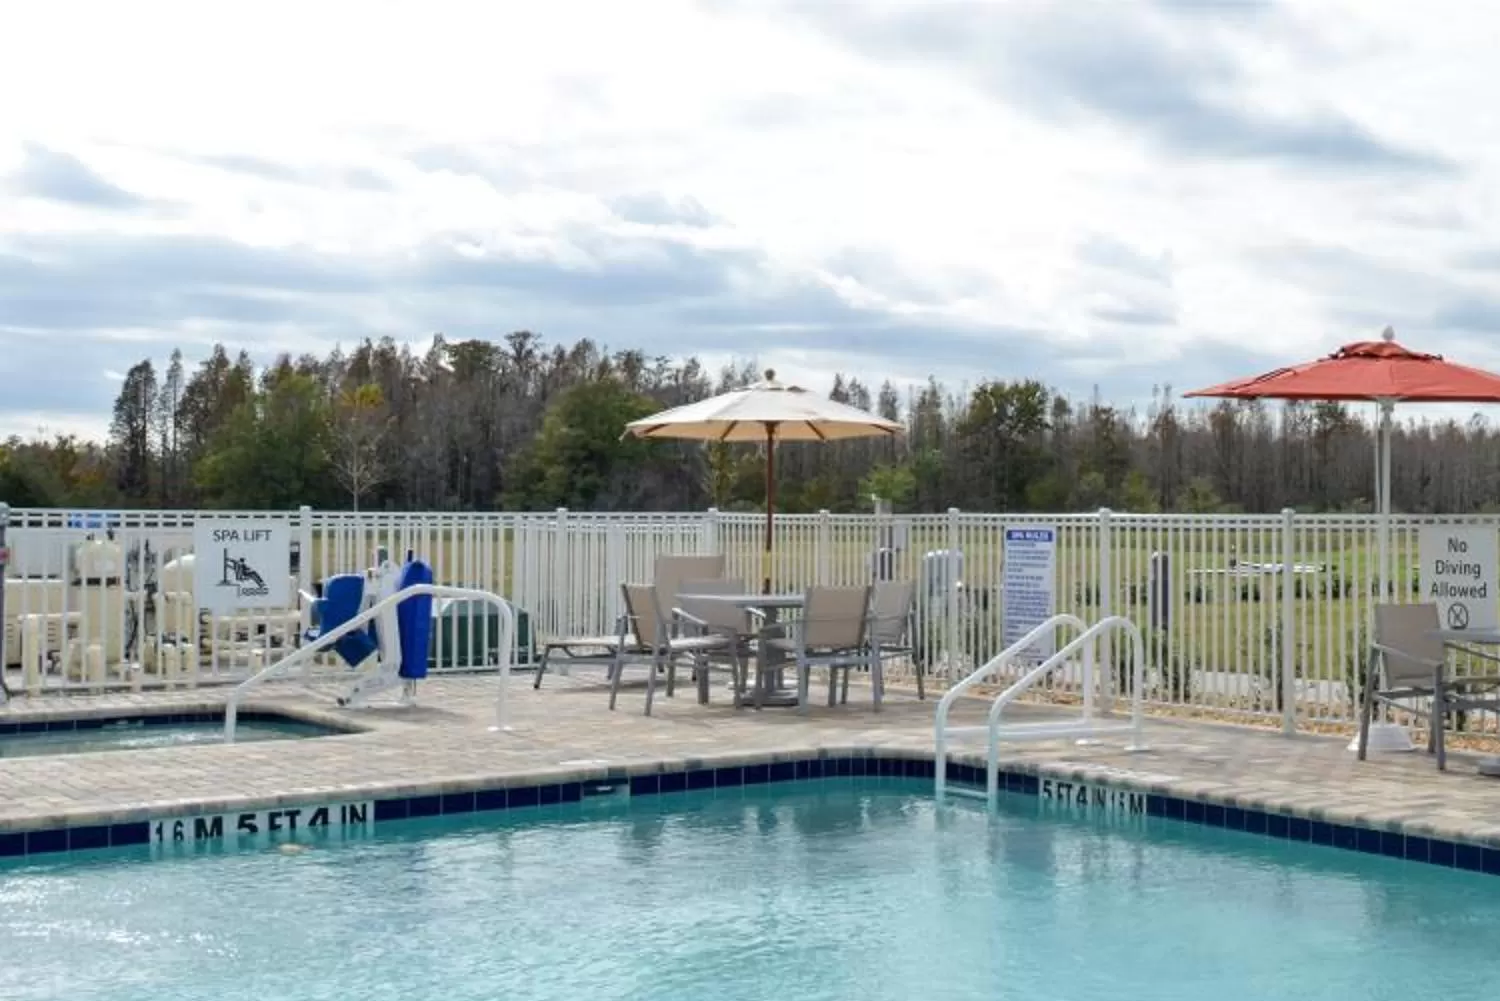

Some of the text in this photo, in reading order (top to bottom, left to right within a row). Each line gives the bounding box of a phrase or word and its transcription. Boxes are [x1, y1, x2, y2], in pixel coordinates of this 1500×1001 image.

[213, 529, 272, 541] SPA LIFT
[1448, 538, 1468, 553] No
[1435, 560, 1481, 579] Diving
[1430, 582, 1487, 598] Allowed
[194, 816, 223, 840] M
[237, 813, 258, 833] 5
[268, 810, 302, 832] FT
[308, 807, 329, 827] 4
[341, 803, 367, 825] IN
